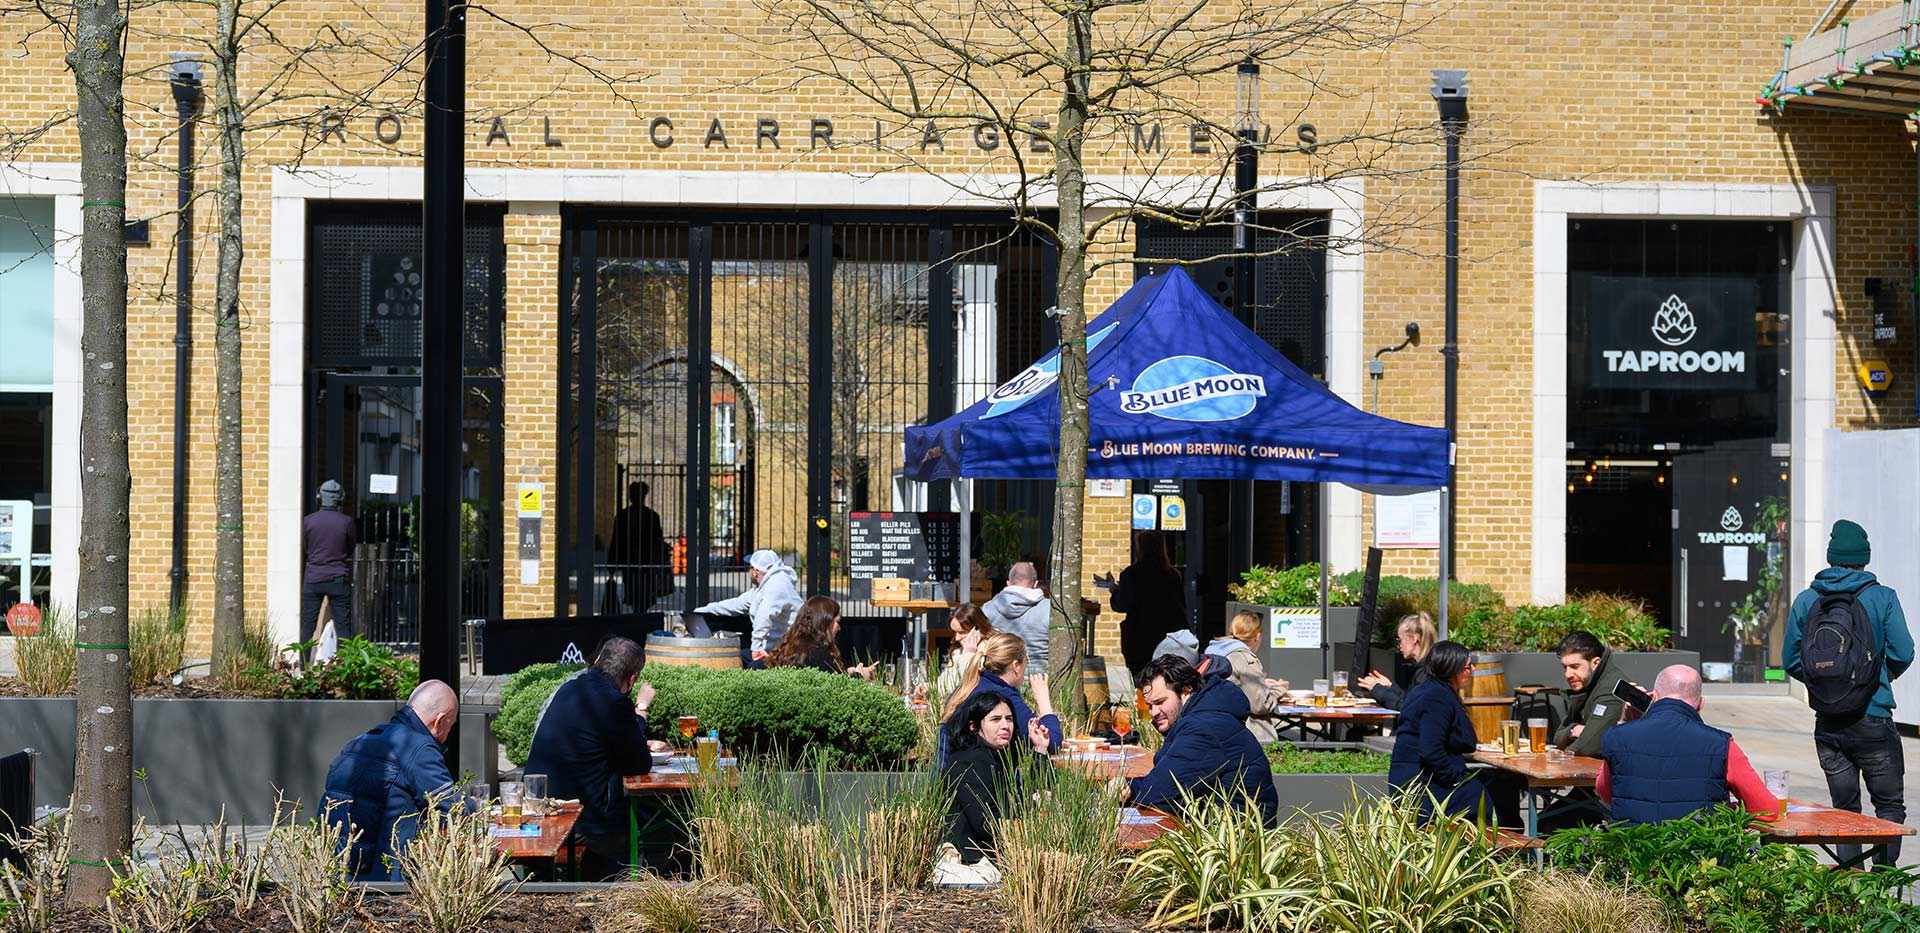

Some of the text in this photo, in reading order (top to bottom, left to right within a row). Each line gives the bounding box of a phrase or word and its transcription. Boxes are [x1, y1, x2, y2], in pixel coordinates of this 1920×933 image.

[321, 112, 1317, 154] ROAL CARRIAGE MES
[1603, 351, 1745, 373] TAPROOM
[1123, 378, 1262, 411] BLUE MOON
[1101, 440, 1139, 458] BLUE
[1142, 442, 1182, 456] MOON
[1186, 443, 1246, 457] BREWING
[1698, 533, 1766, 543] TAPROOM
